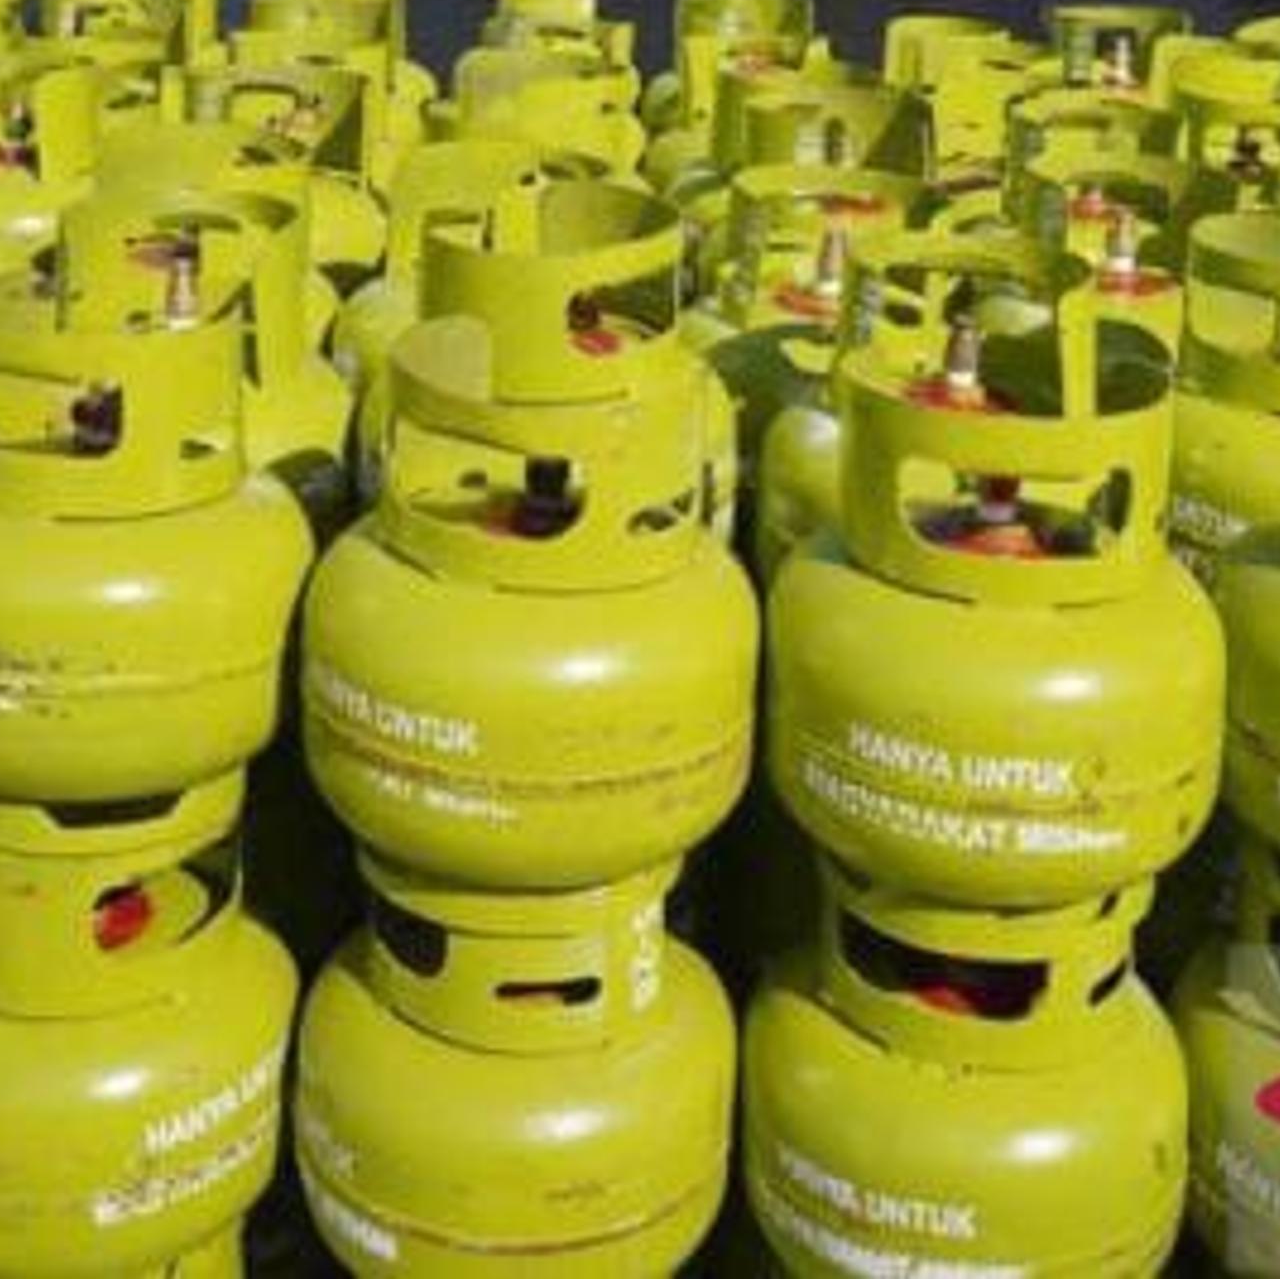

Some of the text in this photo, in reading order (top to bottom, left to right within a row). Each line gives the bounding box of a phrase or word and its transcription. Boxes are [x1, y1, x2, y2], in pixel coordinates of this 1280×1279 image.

[375, 701, 481, 757] UNTUK
[847, 720, 1071, 796] HANYA UNTUK
[867, 1191, 979, 1241] UNTUK
